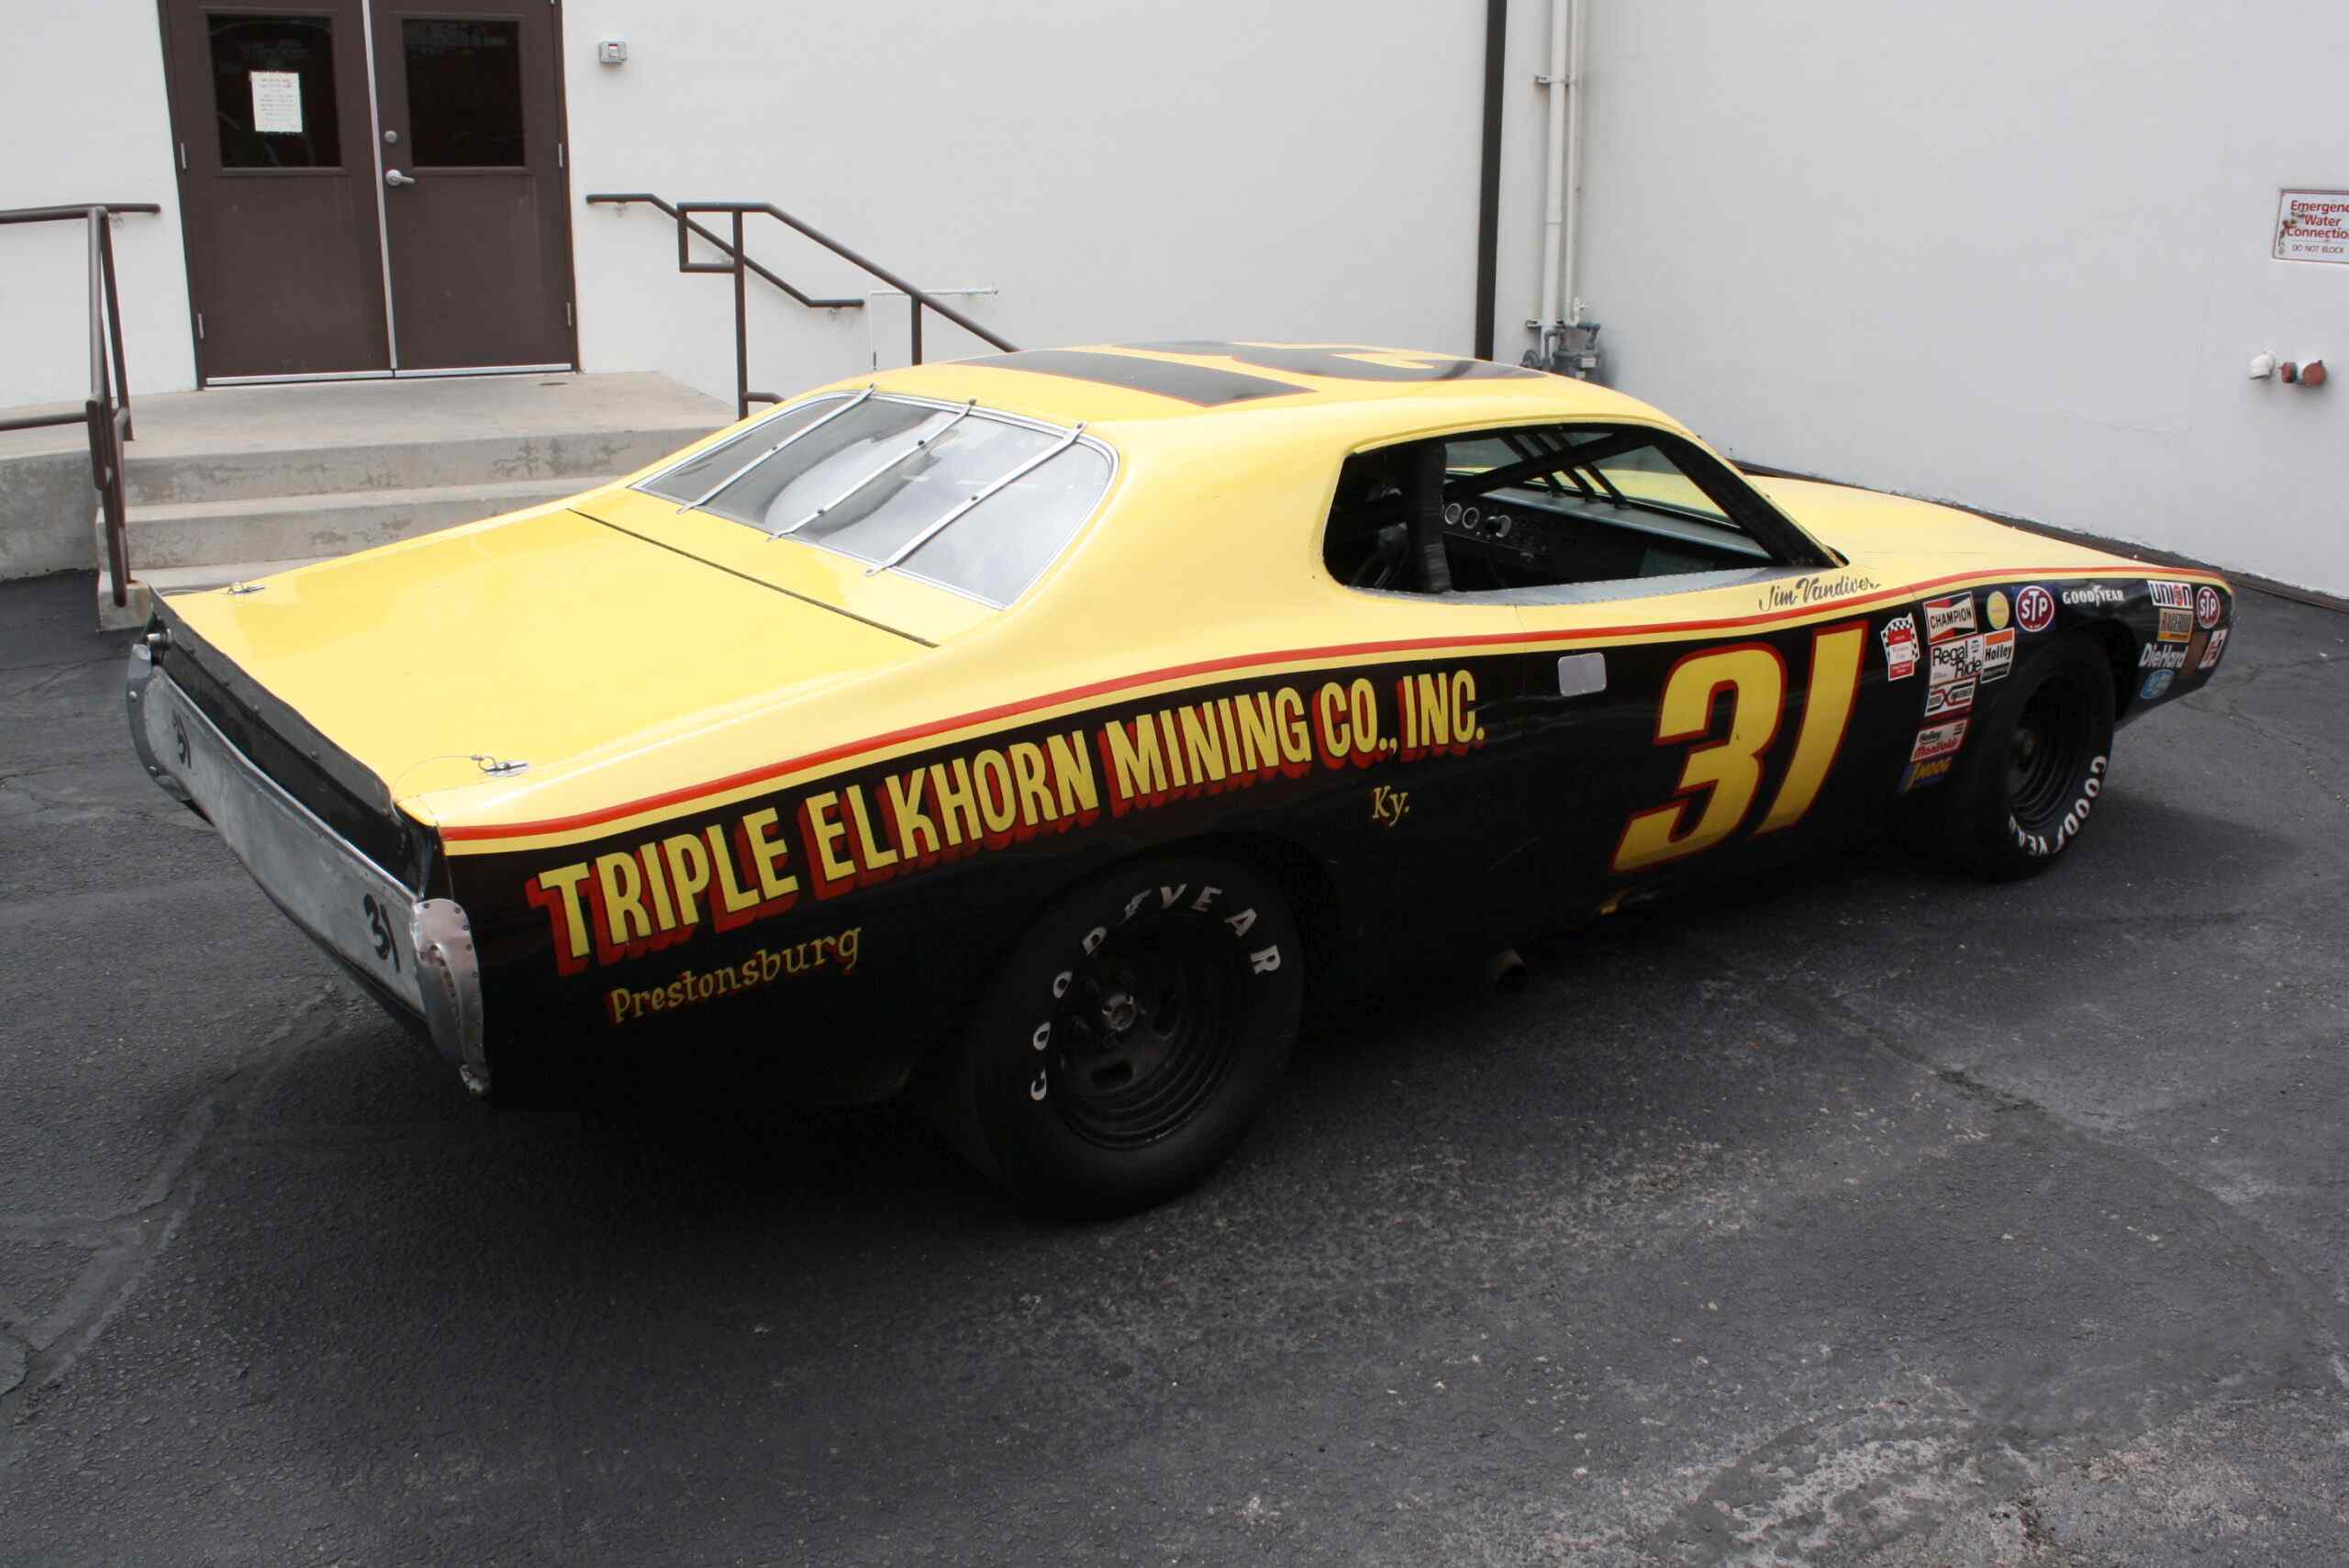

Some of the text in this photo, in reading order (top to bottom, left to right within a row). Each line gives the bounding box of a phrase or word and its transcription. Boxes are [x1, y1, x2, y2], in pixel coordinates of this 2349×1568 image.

[2287, 227, 2349, 239] Connectio
[2304, 215, 2342, 227] Water
[1758, 584, 1798, 612] Jim
[2021, 590, 2049, 622] STP
[2199, 591, 2217, 619] STP
[1930, 608, 1973, 629] CHAMPION
[1932, 640, 1968, 667] Regal
[1985, 644, 2012, 662] Holley
[2138, 642, 2188, 669] DieHard
[1954, 657, 1982, 679] Ride
[1611, 621, 1867, 873] 31
[535, 806, 799, 962] TRIPLE
[804, 730, 1099, 884] ELKHORN
[1104, 686, 1311, 801] MINING
[1403, 670, 1486, 750] INC.
[1372, 784, 1410, 828] Ky.
[363, 894, 401, 973] 31
[609, 927, 863, 1025] Prestonsburg
